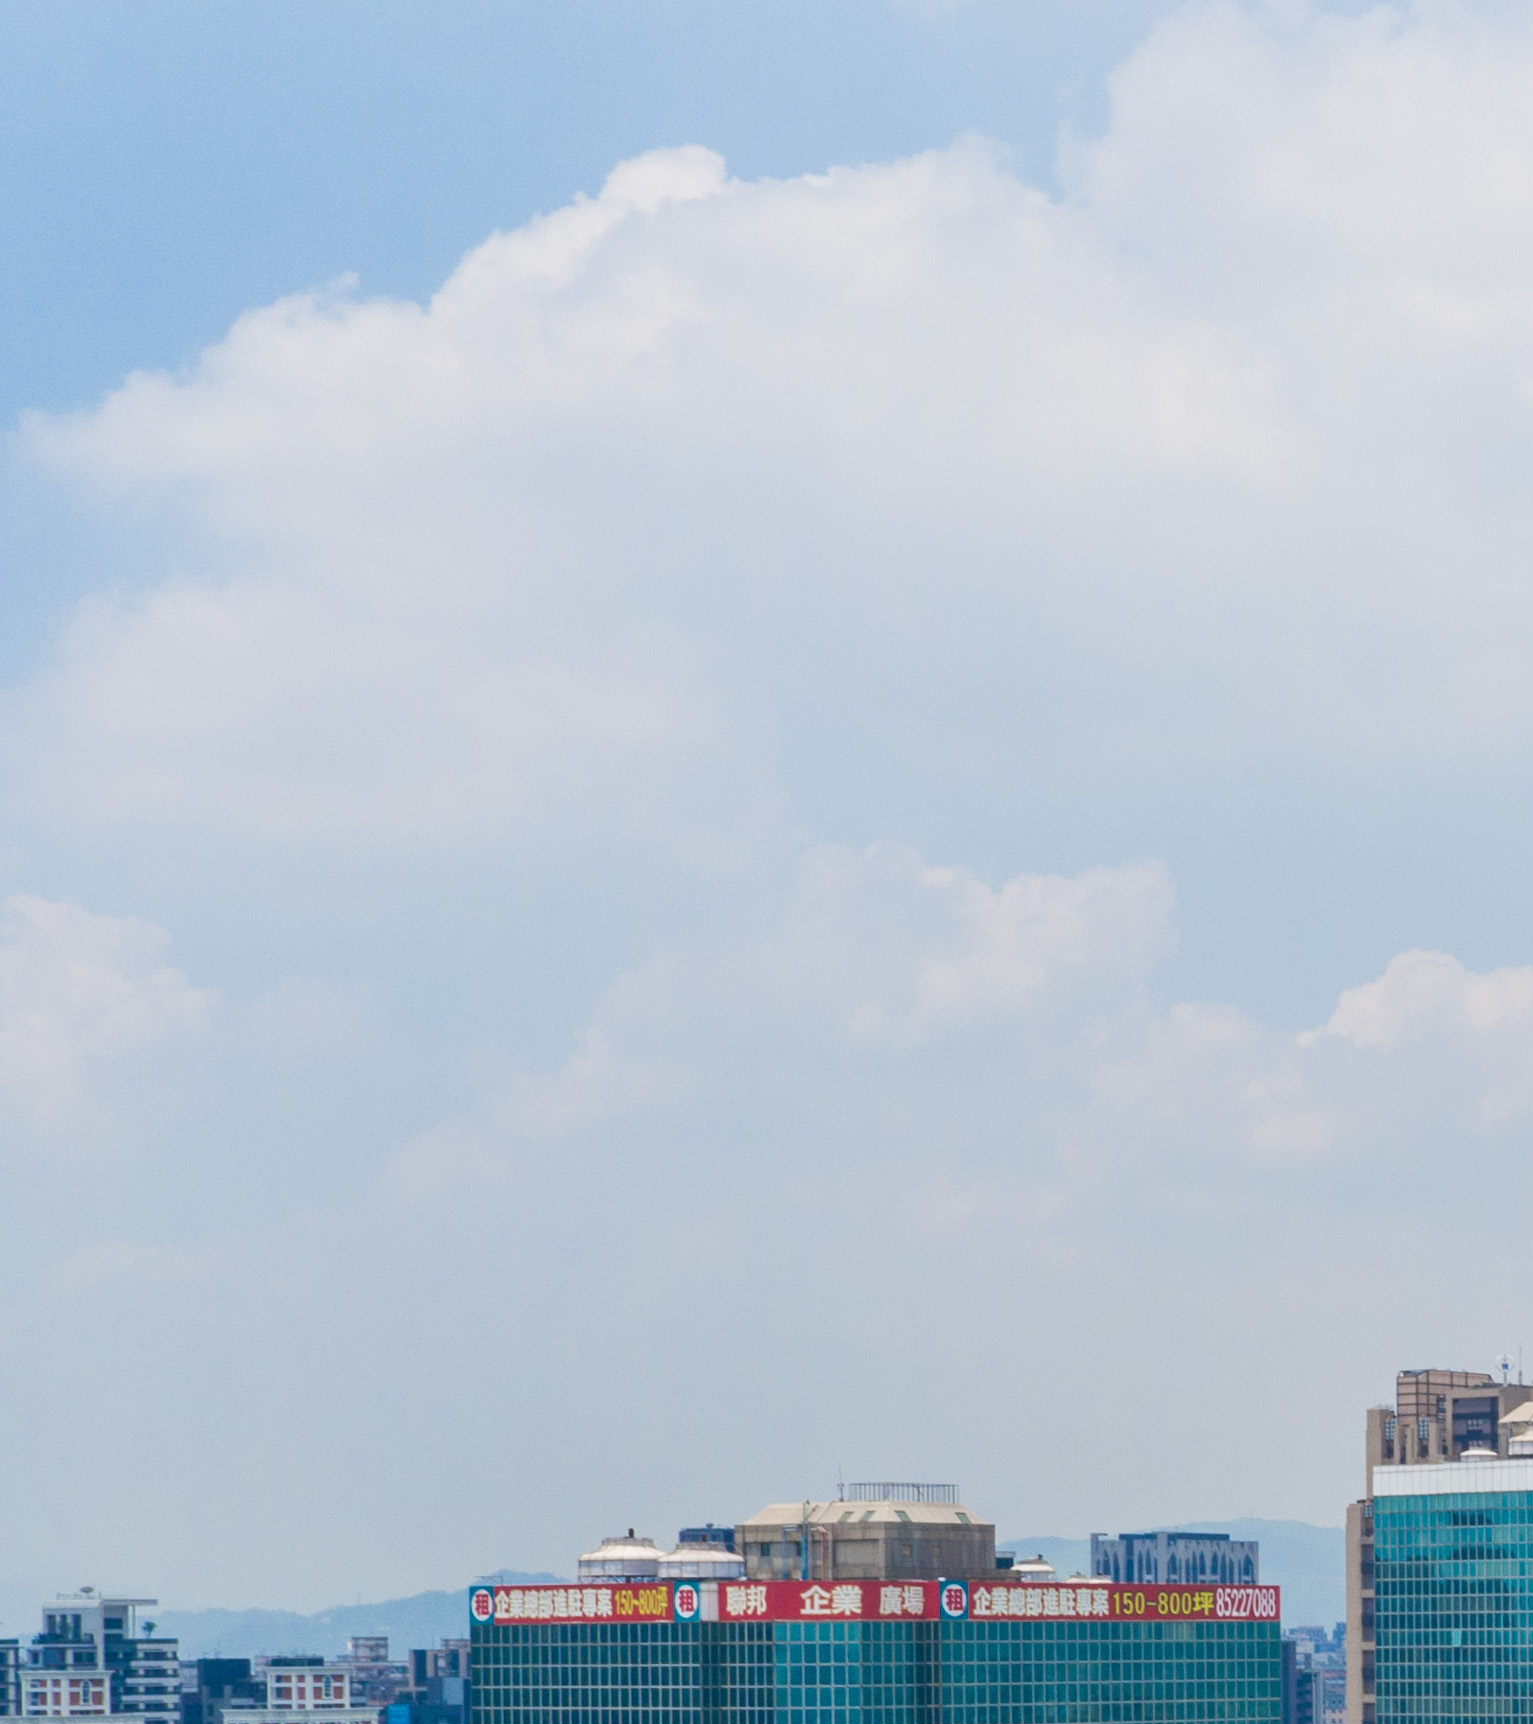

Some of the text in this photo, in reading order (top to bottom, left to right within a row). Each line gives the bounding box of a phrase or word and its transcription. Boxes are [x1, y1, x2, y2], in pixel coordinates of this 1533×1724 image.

[475, 1593, 489, 1615] 租
[494, 1588, 613, 1618] 企業總部進駐專案
[678, 1589, 694, 1612] 租
[726, 1585, 925, 1615] 聯邦 企業 廣場
[946, 1588, 964, 1612] 租
[973, 1586, 1109, 1617] 企業總部進駐專案
[1216, 1587, 1276, 1617] 85227088
